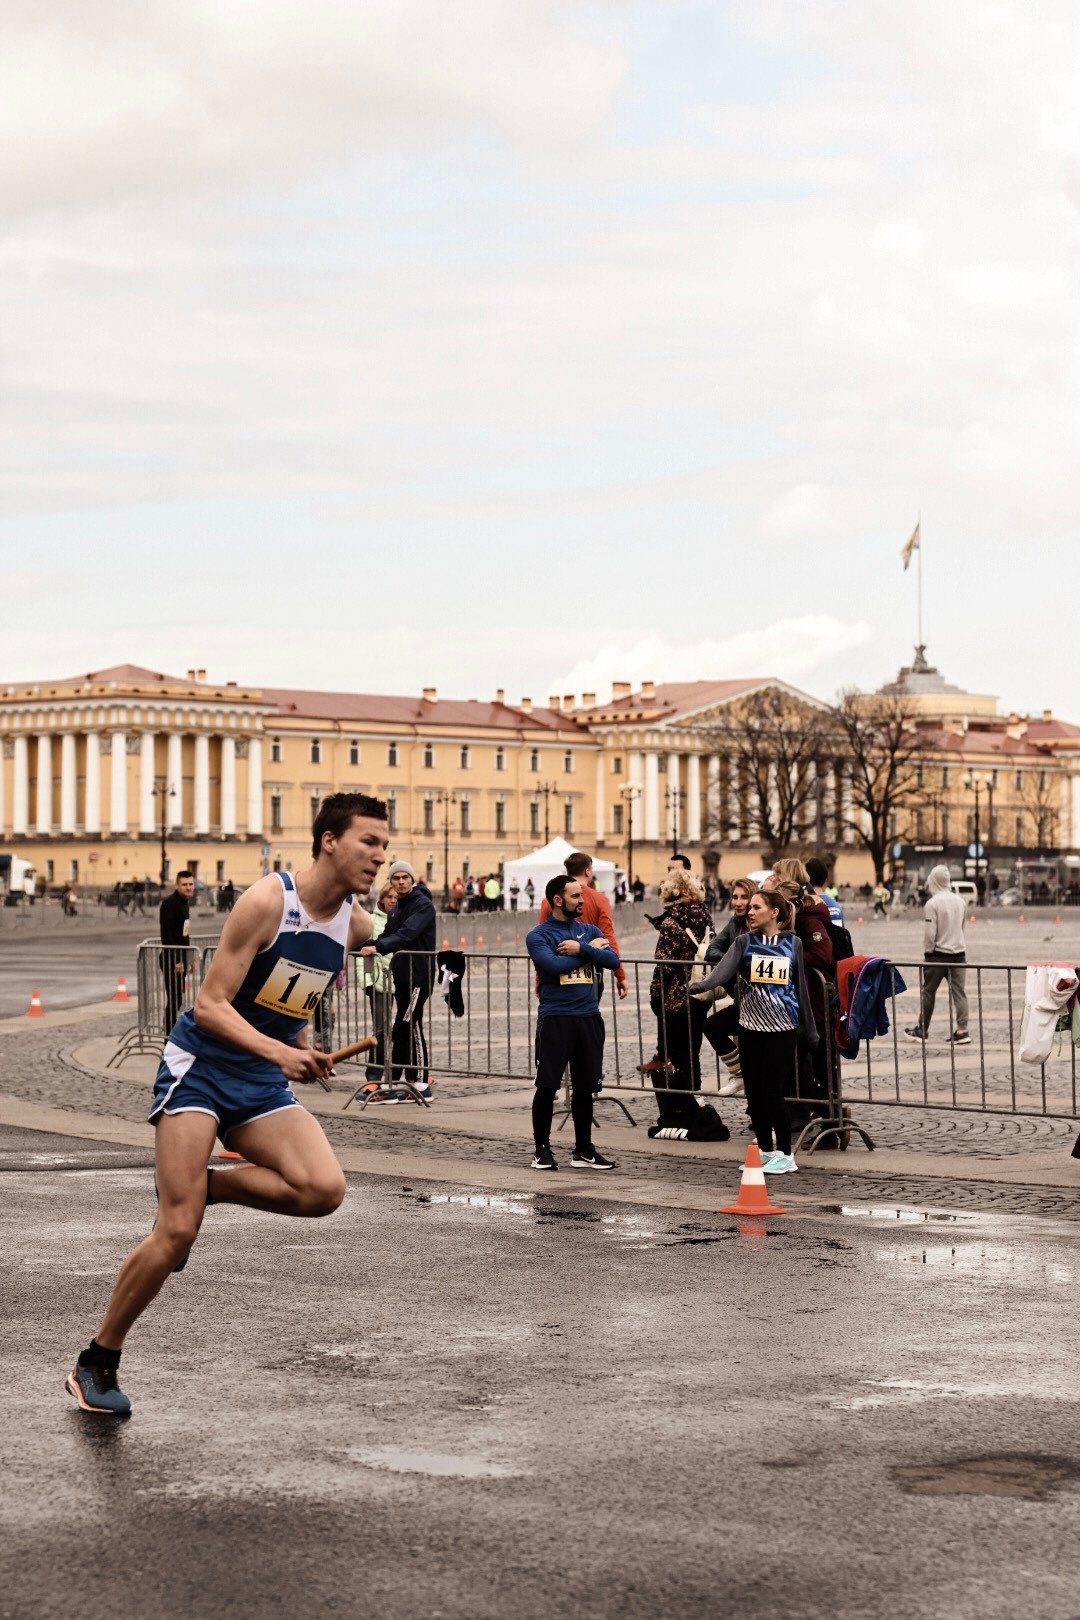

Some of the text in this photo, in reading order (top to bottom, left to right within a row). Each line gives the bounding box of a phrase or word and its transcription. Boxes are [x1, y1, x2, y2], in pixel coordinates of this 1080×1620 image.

[583, 968, 591, 978] 16
[756, 960, 786, 979] 44 11
[278, 973, 301, 1003] 1
[302, 991, 320, 1010] 16
